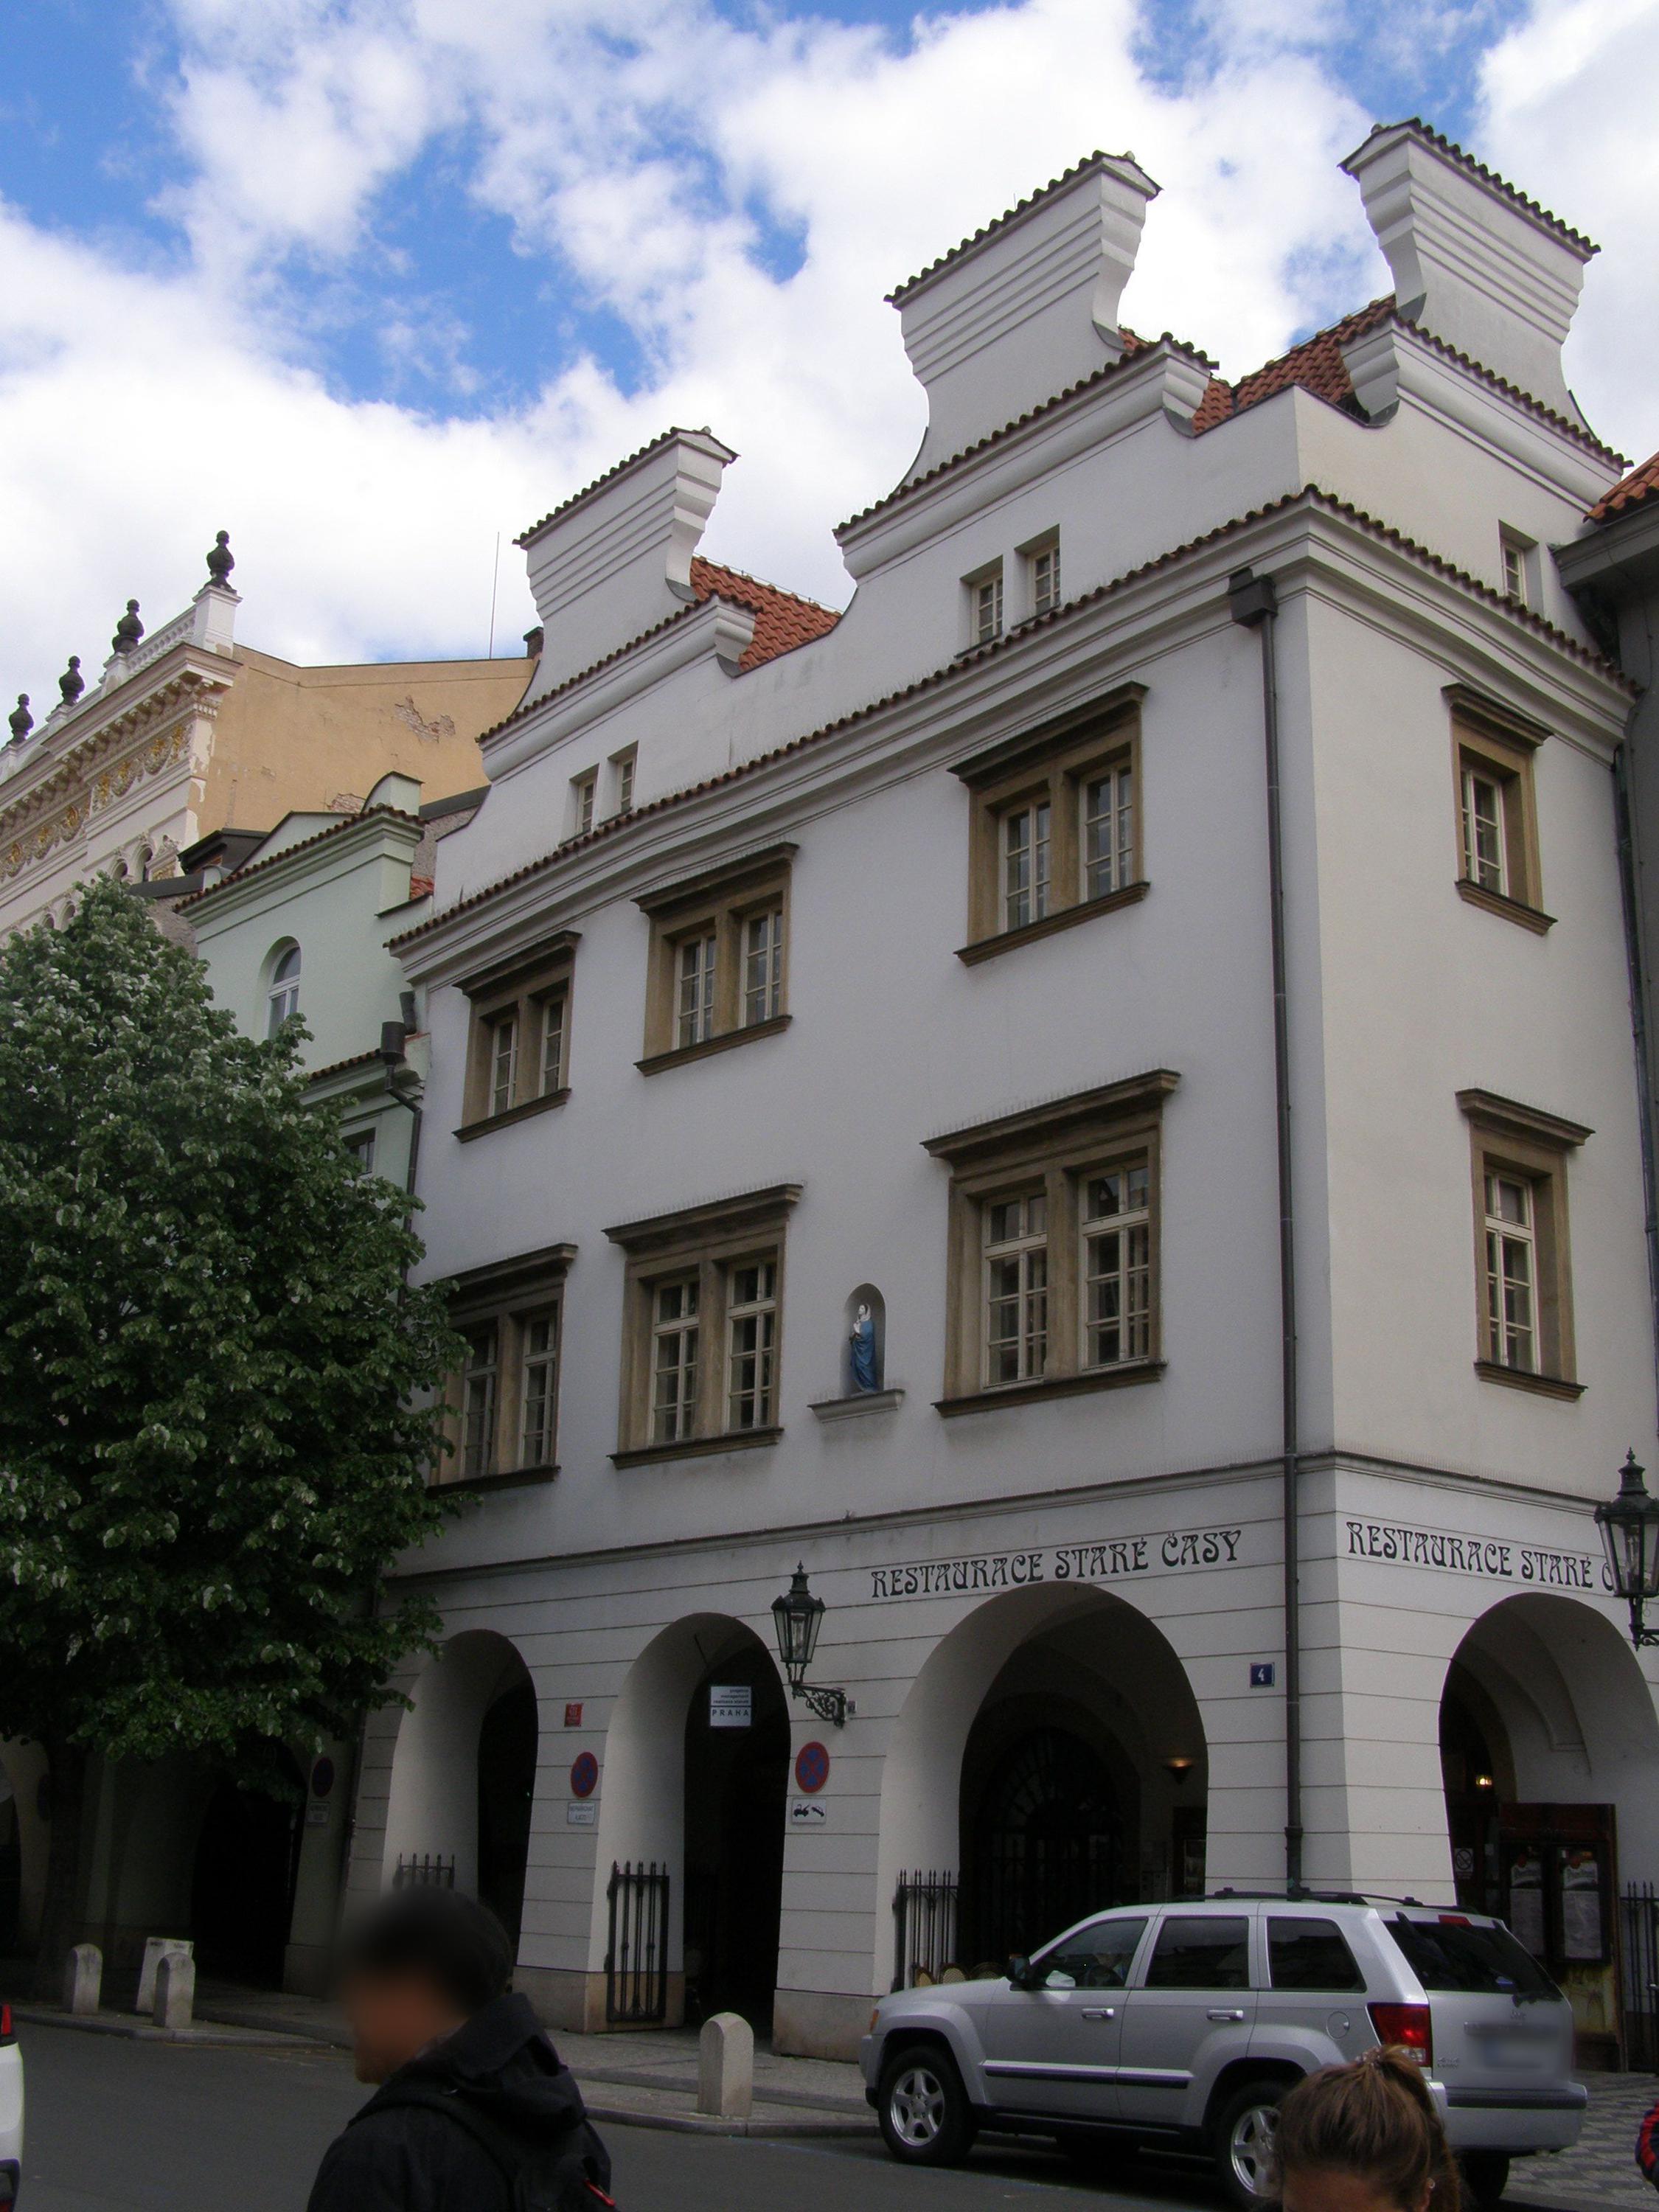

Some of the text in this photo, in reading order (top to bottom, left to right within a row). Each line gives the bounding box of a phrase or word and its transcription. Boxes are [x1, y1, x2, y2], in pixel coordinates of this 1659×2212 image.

[872, 1554, 1044, 1598] RESTAURACE
[1055, 1538, 1149, 1579] STARÉ
[1346, 1521, 1512, 1576] RESTAURACE
[1521, 1550, 1594, 1589] STARÉ
[1258, 1668, 1265, 1682] 4
